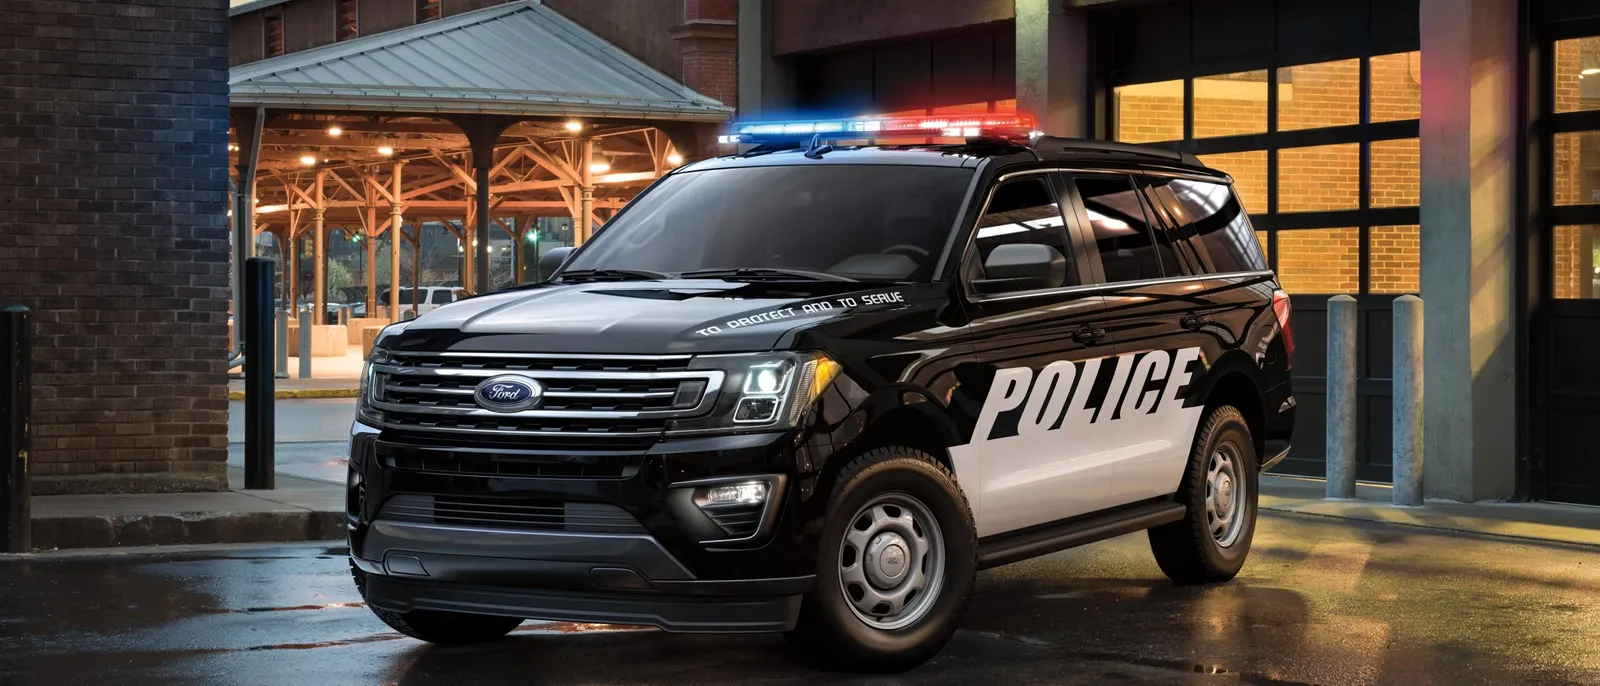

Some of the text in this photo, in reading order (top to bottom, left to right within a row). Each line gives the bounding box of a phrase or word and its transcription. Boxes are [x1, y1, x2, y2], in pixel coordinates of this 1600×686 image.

[695, 325, 723, 337] TO
[726, 307, 796, 329] PROTECT
[801, 300, 834, 315] AND
[836, 296, 858, 309] TO
[488, 383, 521, 400] Ford
[969, 346, 1201, 443] POLICE
